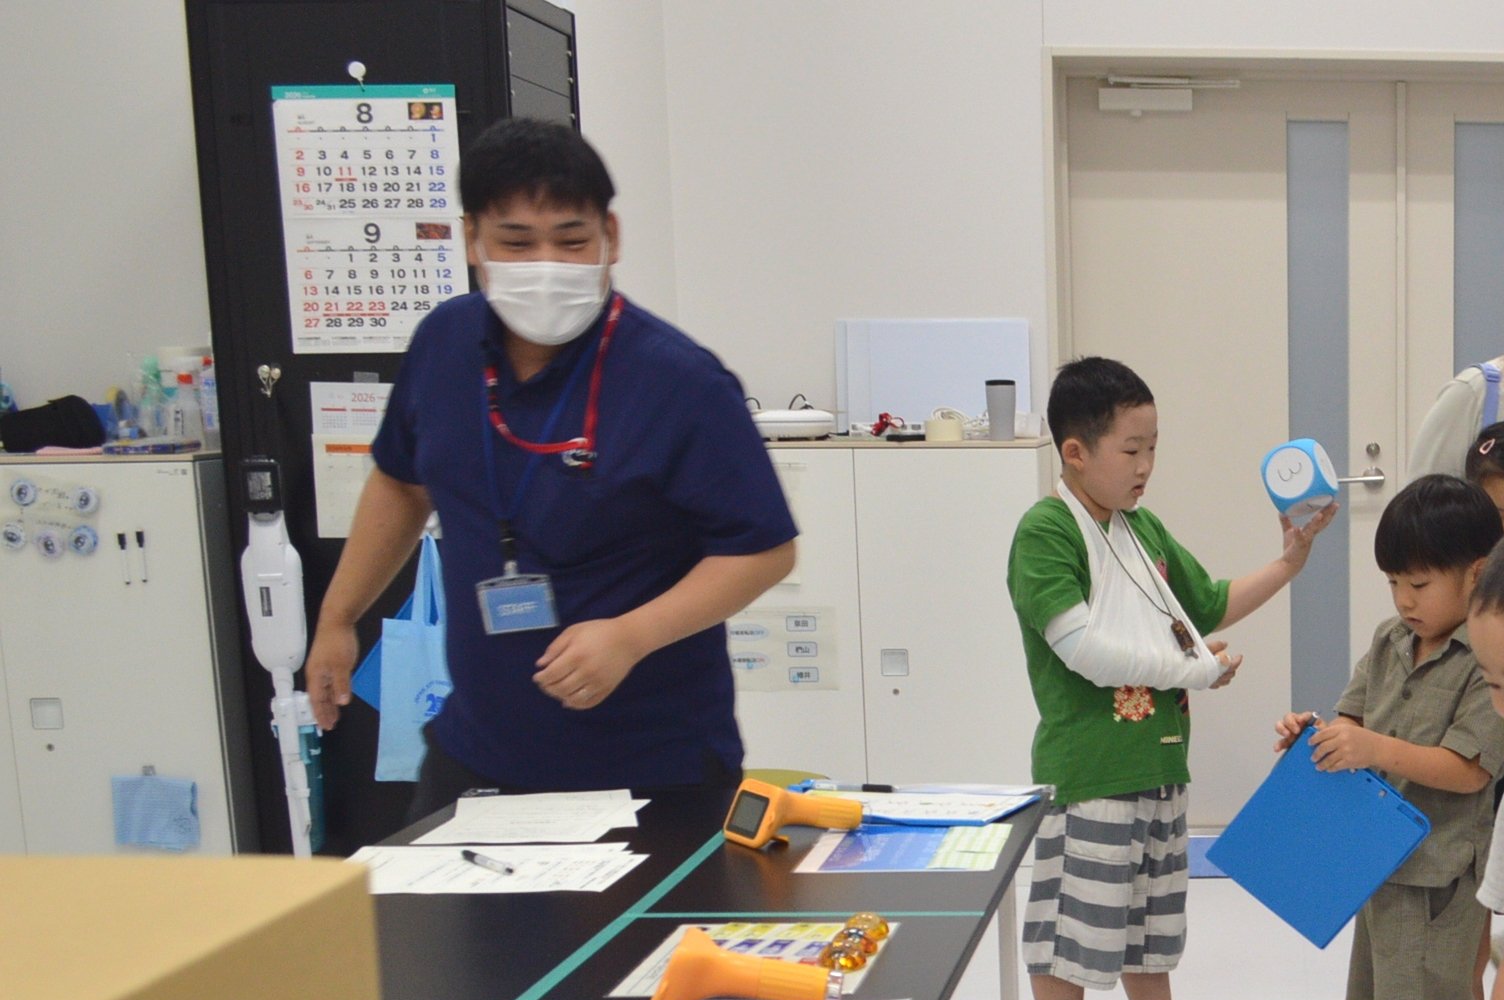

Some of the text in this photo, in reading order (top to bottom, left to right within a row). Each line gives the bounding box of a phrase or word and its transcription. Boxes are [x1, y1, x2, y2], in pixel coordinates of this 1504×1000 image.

[357, 103, 373, 123] 8
[431, 134, 436, 142] 1
[296, 150, 439, 160] 2 3 4 5 6 7 8
[297, 166, 444, 176] 9 10 11 12 13 14 15
[295, 182, 445, 193] 16 17 18 19 20 21 22
[339, 199, 356, 209] 25
[362, 199, 379, 209] 26
[384, 199, 400, 208] 27
[407, 199, 424, 208] 28
[429, 199, 446, 208] 29
[364, 223, 381, 243] 9
[349, 253, 446, 262] 1 2 3 4 5
[305, 269, 452, 280] 6 7 8 9 10 11 12
[304, 285, 452, 296] 13 14 15 16 17 18 19
[303, 301, 431, 312] 20 21 22 23 24 25
[305, 318, 387, 328] 27 28 29 30
